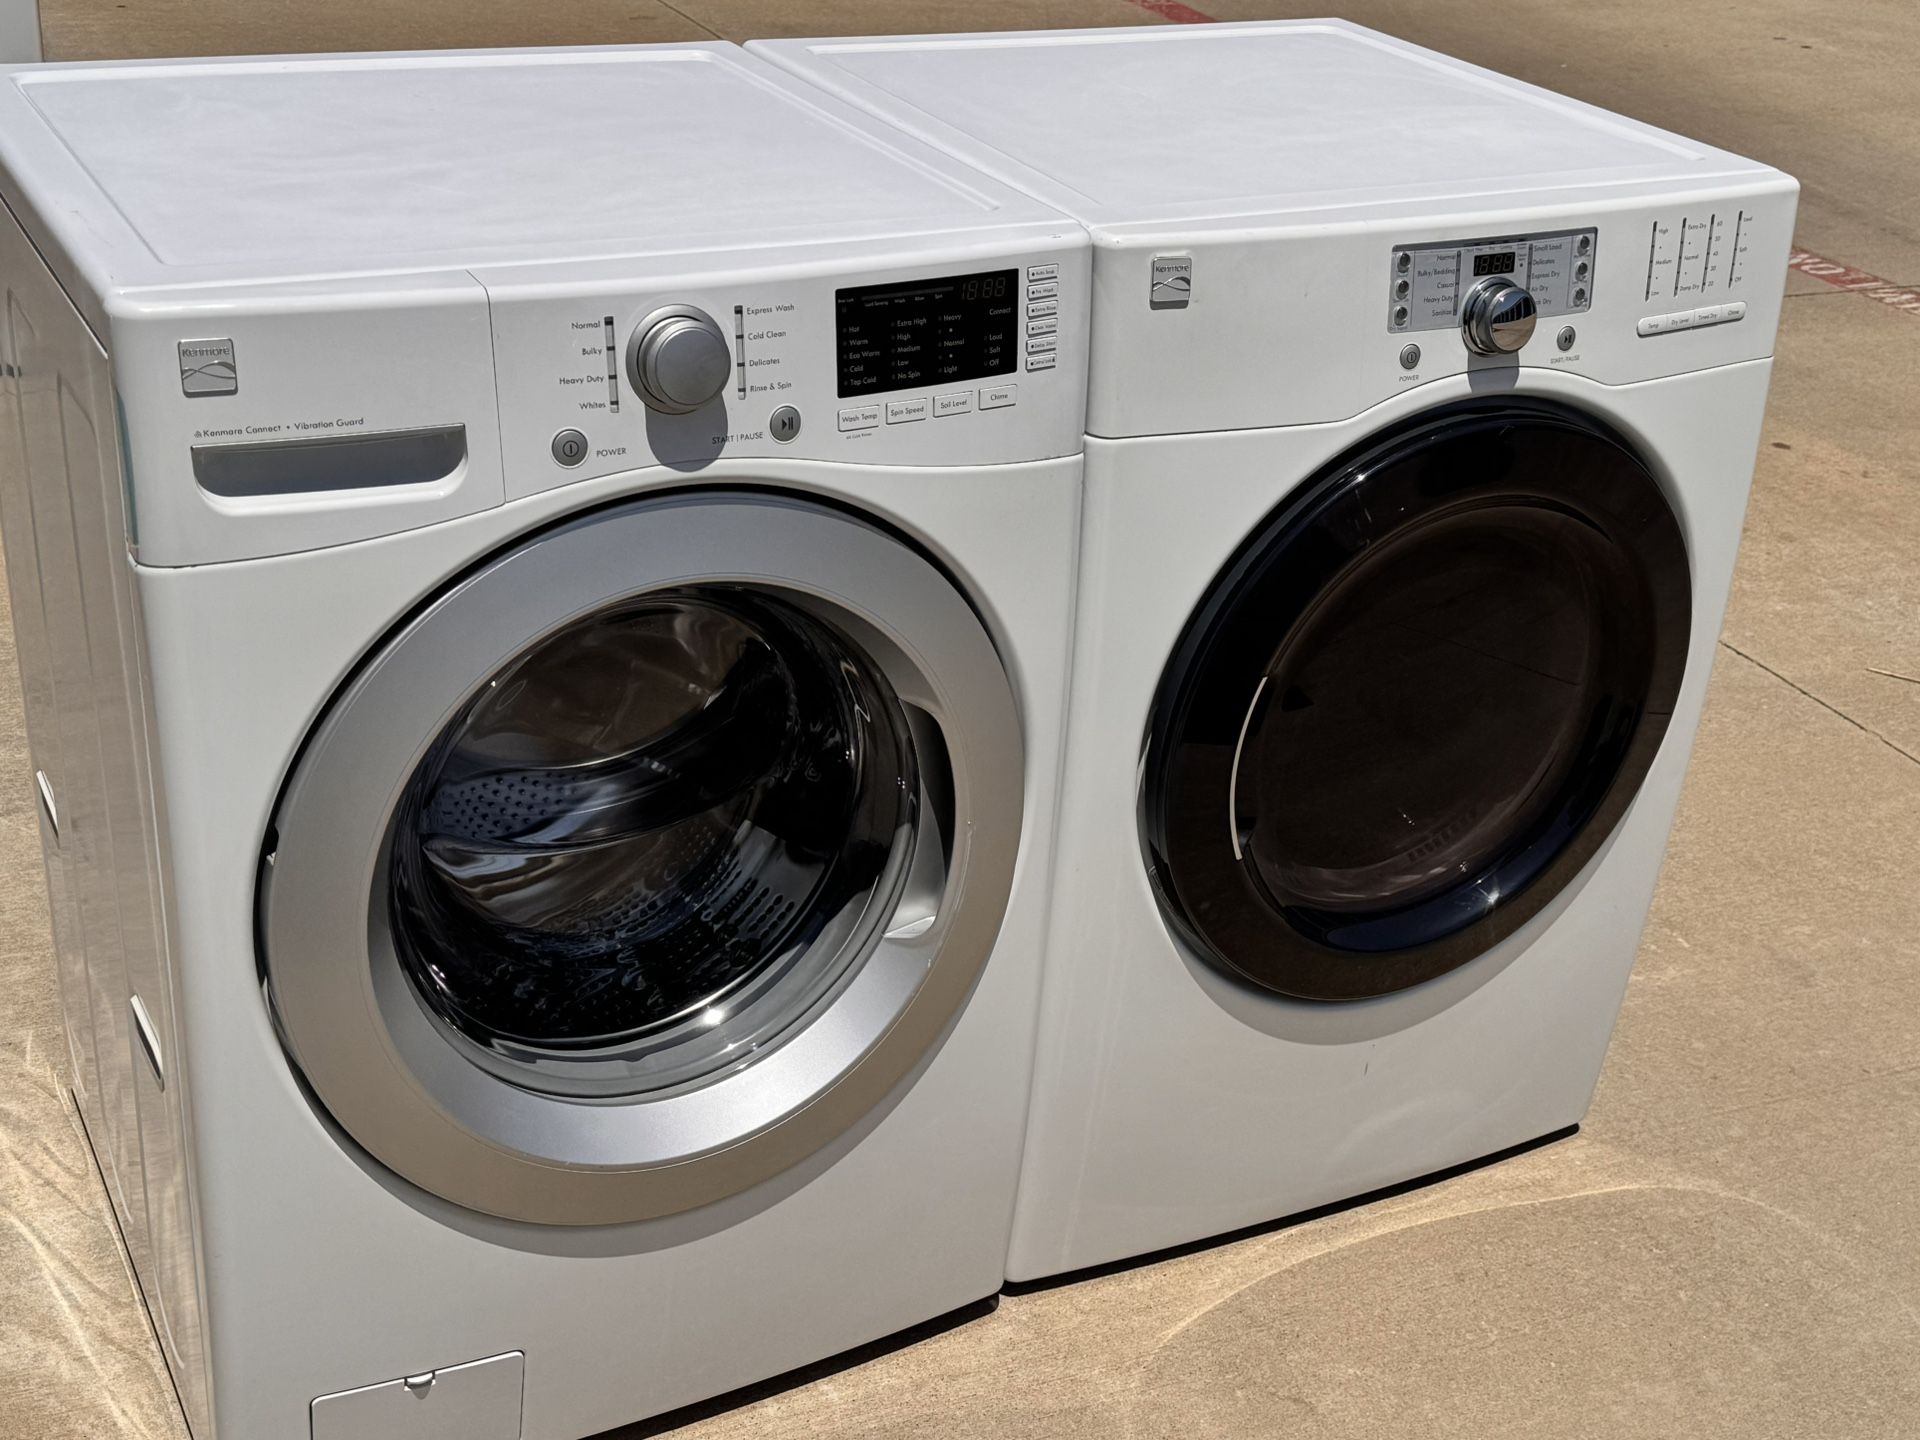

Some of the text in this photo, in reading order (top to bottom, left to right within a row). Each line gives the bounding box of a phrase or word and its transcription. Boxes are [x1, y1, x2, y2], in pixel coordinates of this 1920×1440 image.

[1424, 296, 1441, 304] Heavy
[746, 303, 795, 316] Express Wash
[990, 307, 1011, 316] Connect
[914, 317, 927, 326] High
[944, 314, 962, 322] Heavy
[571, 320, 601, 330] Normal
[849, 326, 860, 334] Hot
[748, 330, 786, 340] Cold Clean
[897, 333, 911, 341] High
[849, 338, 868, 346] Warm
[944, 338, 964, 347] Normal
[181, 345, 231, 358] Kenmore
[582, 346, 602, 357] Bulky
[897, 345, 921, 353] Medium
[990, 346, 1000, 354] Soft
[849, 350, 880, 360] Eco Warm
[749, 357, 780, 366] Delicates
[850, 365, 864, 373] Cold
[944, 366, 958, 374] Light
[909, 370, 920, 379] Spin
[1399, 374, 1420, 382] POWER
[559, 374, 604, 386] Heavy Duty
[863, 376, 876, 384] Cold
[750, 380, 792, 393] Rinse & Spin
[990, 393, 1008, 401] Chime
[579, 400, 606, 410] Whites
[940, 398, 967, 409] Soil Level
[890, 405, 924, 418] Spin Speed
[842, 412, 878, 422] Wash Temp
[203, 418, 364, 438] Kenmore Connect Vibration Guard
[596, 447, 627, 457] POWER
